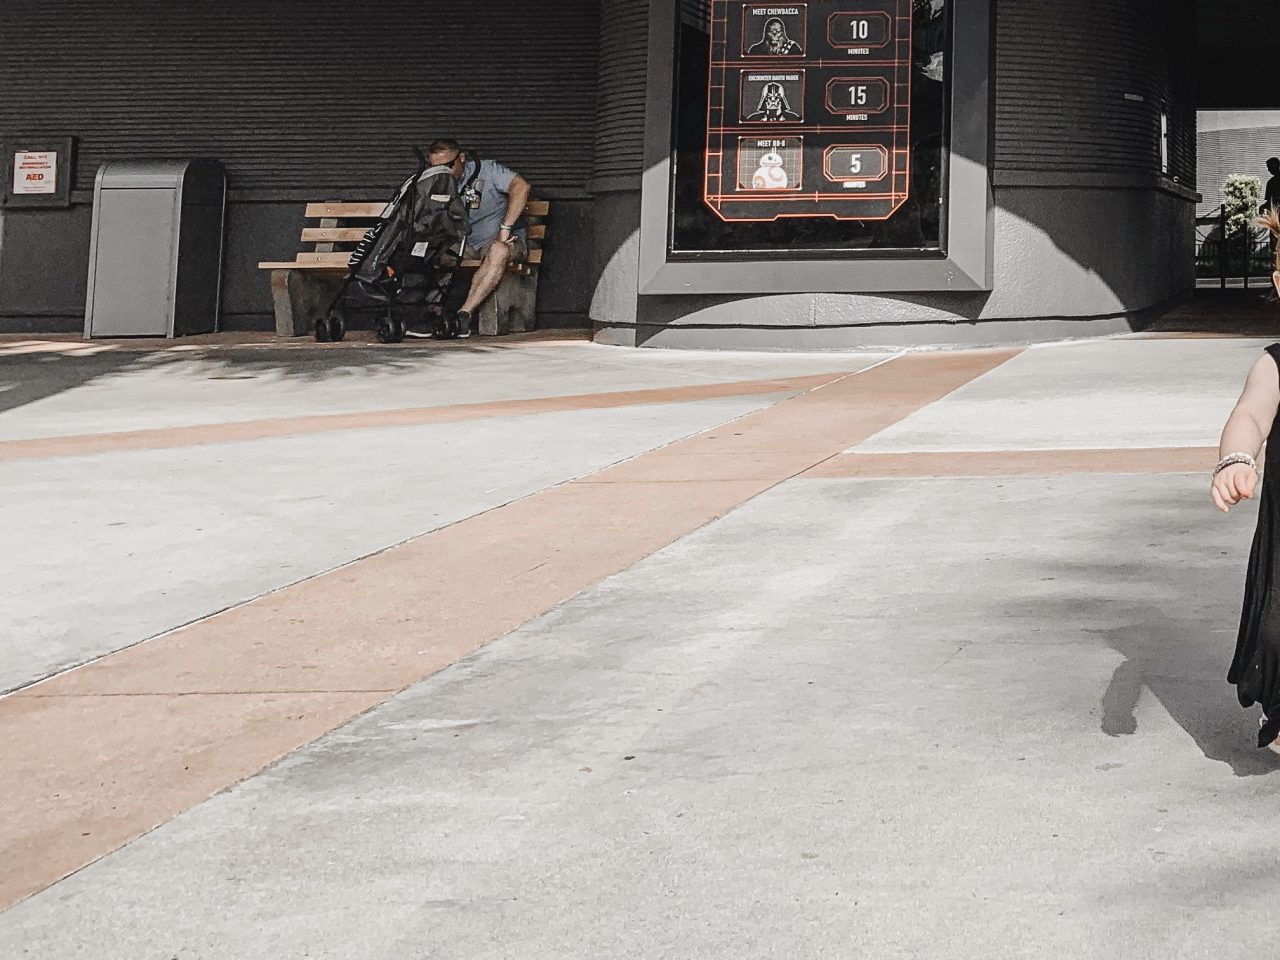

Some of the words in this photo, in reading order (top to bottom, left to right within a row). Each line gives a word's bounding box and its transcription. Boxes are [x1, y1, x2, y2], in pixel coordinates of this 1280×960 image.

[752, 8, 767, 16] MEET
[850, 20, 868, 39] 10
[848, 86, 867, 105] 15
[849, 154, 862, 174] 5
[26, 173, 44, 181] AED
